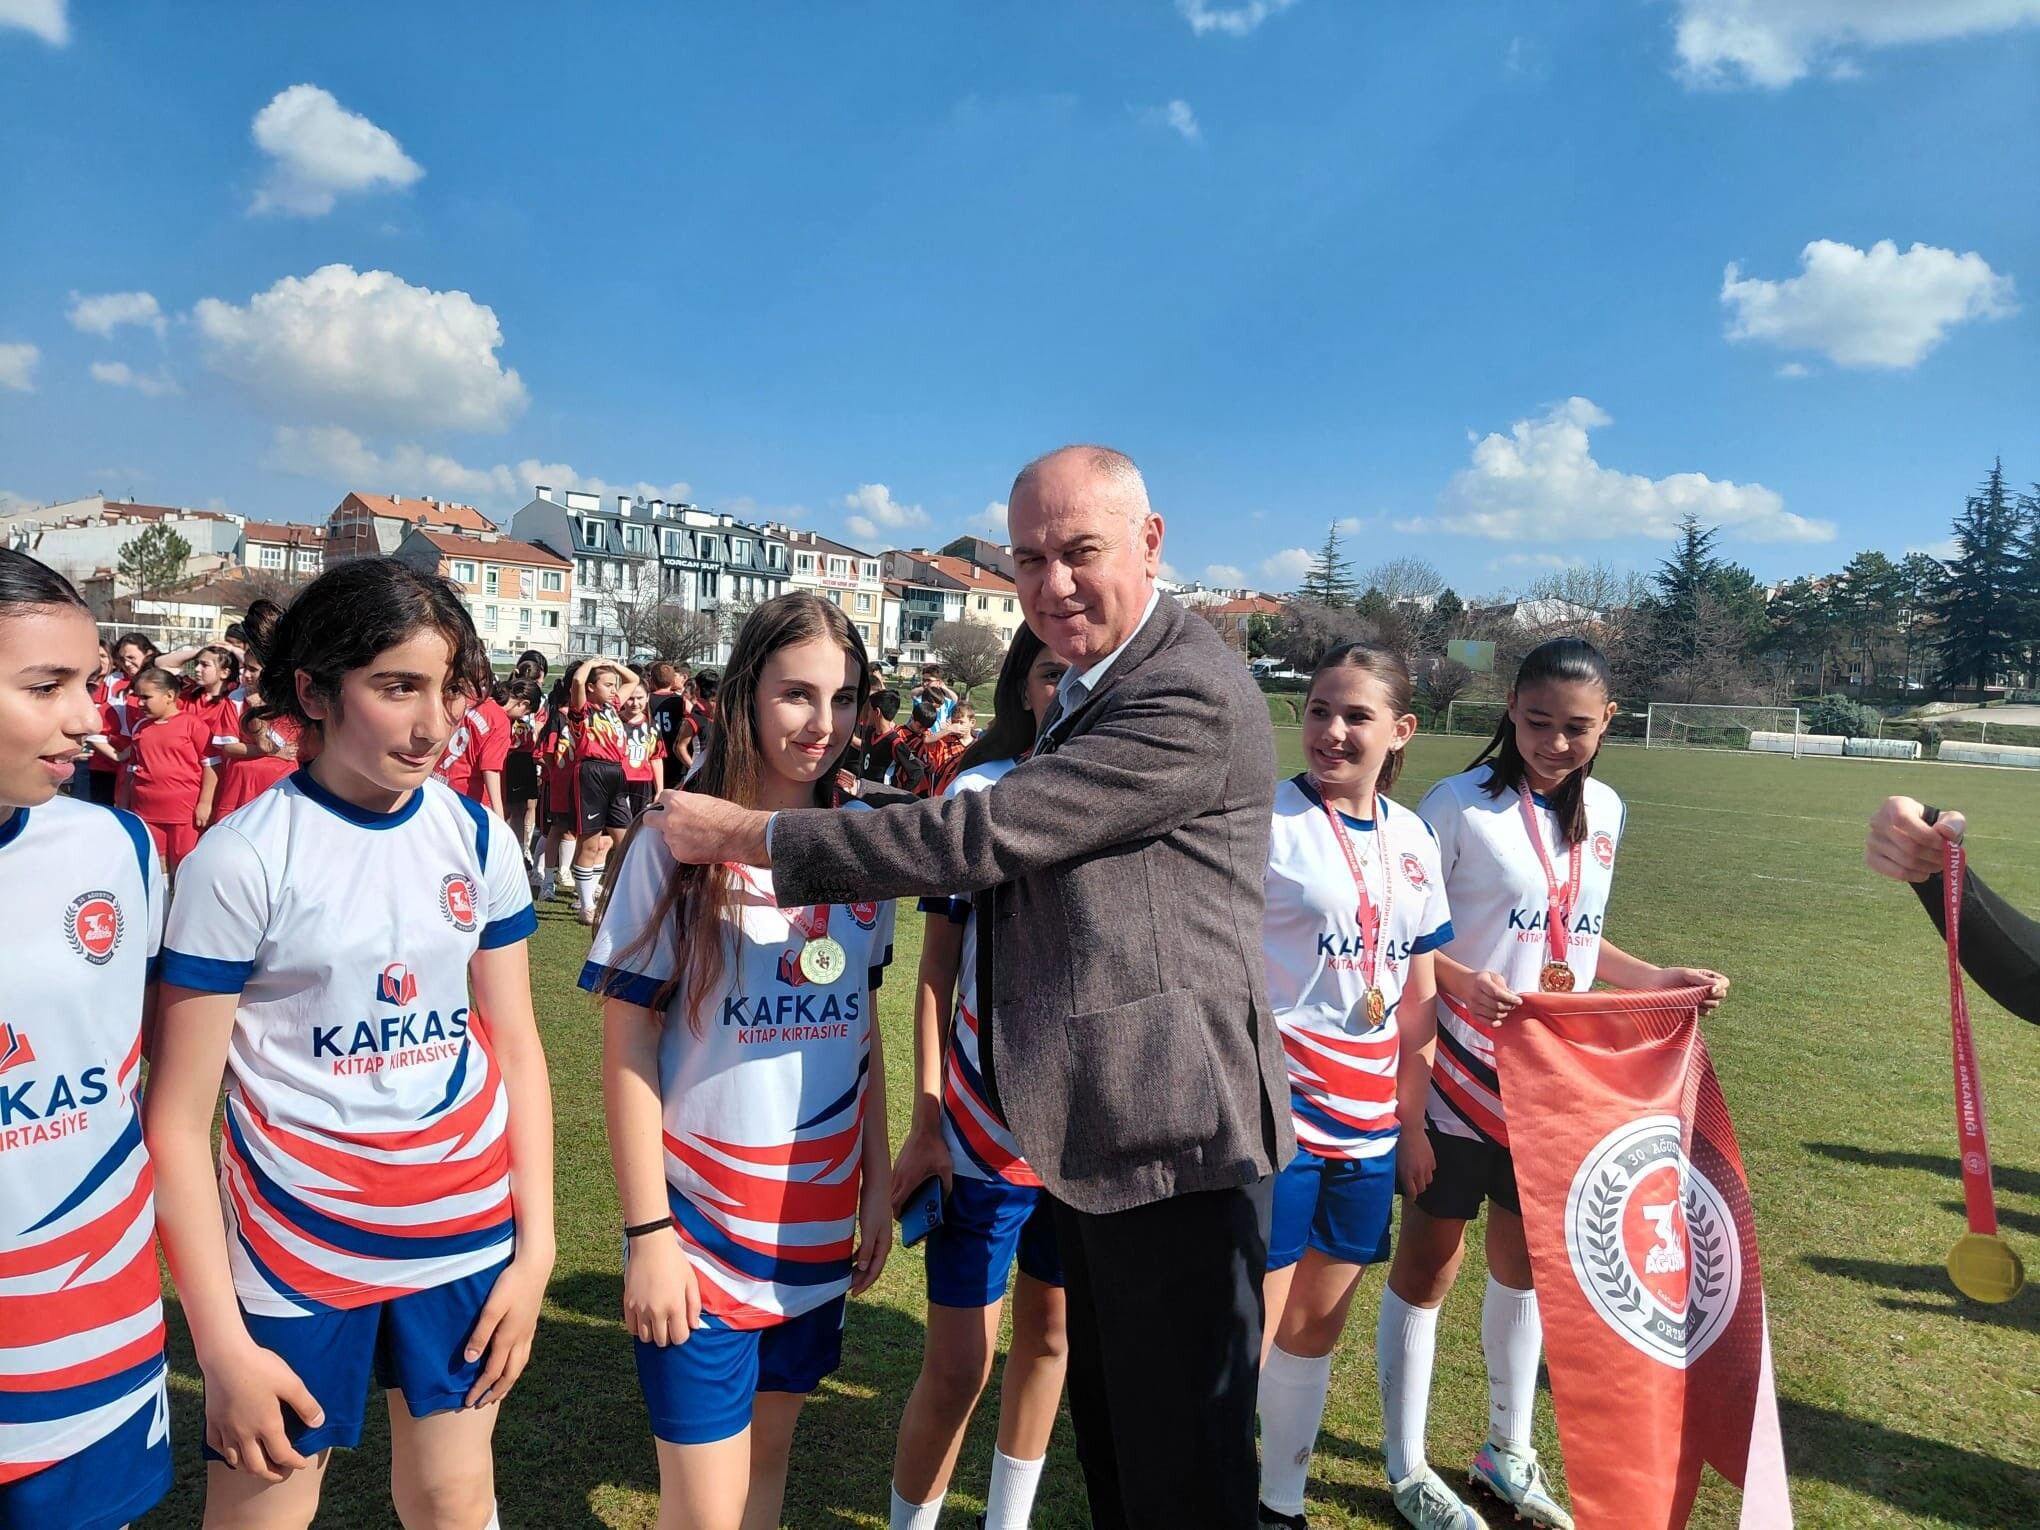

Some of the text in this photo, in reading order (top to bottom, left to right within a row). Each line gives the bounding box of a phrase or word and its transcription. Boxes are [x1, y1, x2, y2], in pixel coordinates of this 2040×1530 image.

[655, 711, 672, 732] 15
[629, 743, 646, 761] 10
[863, 753, 871, 770] 6
[723, 993, 858, 1027] KAFKAS
[312, 1008, 468, 1057] KAFKAS
[738, 1022, 848, 1044] KİTAP KIRTASİYE
[333, 1042, 458, 1075] KİTAP KIRTASİYE
[0, 1067, 107, 1126] KAS
[1959, 1065, 1977, 1137] BAKANLIĞI
[0, 1111, 88, 1152] IRTASİYE
[1627, 1149, 1645, 1166] 30
